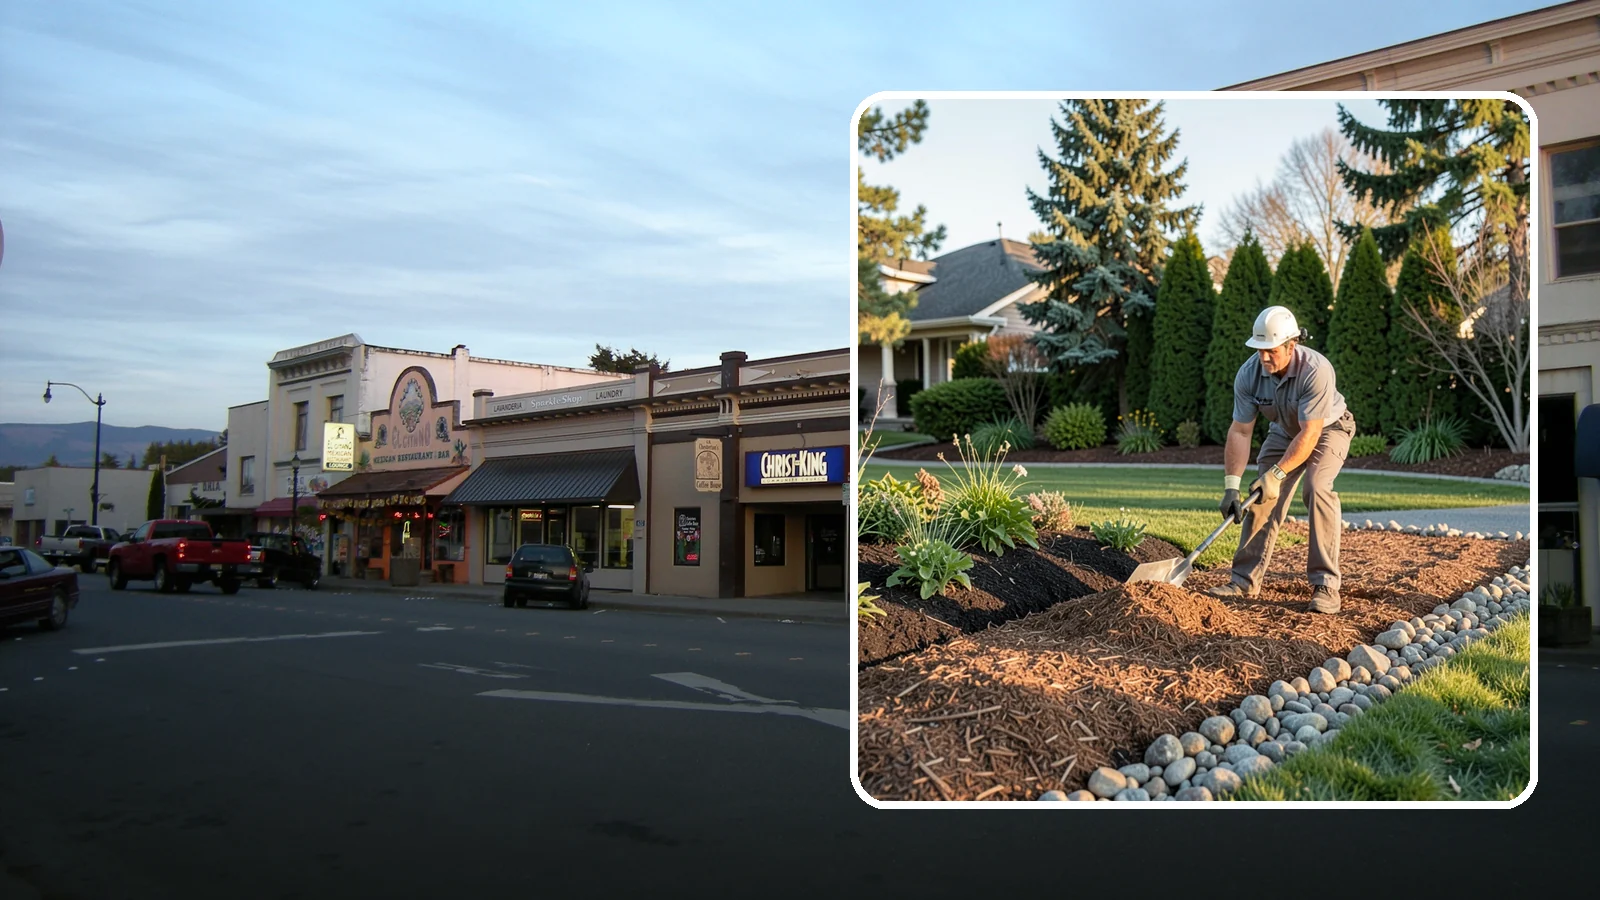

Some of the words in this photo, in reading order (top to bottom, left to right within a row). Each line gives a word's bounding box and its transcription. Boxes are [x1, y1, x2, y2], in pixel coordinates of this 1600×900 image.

[595, 389, 623, 400] LAUNDRY
[493, 402, 523, 412] LAVANDERIA
[531, 396, 561, 409] Sparkle
[562, 395, 582, 406] Shop
[373, 455, 396, 464] MEXICAN
[397, 451, 433, 462] RESTAURANT
[437, 450, 450, 459] BAR
